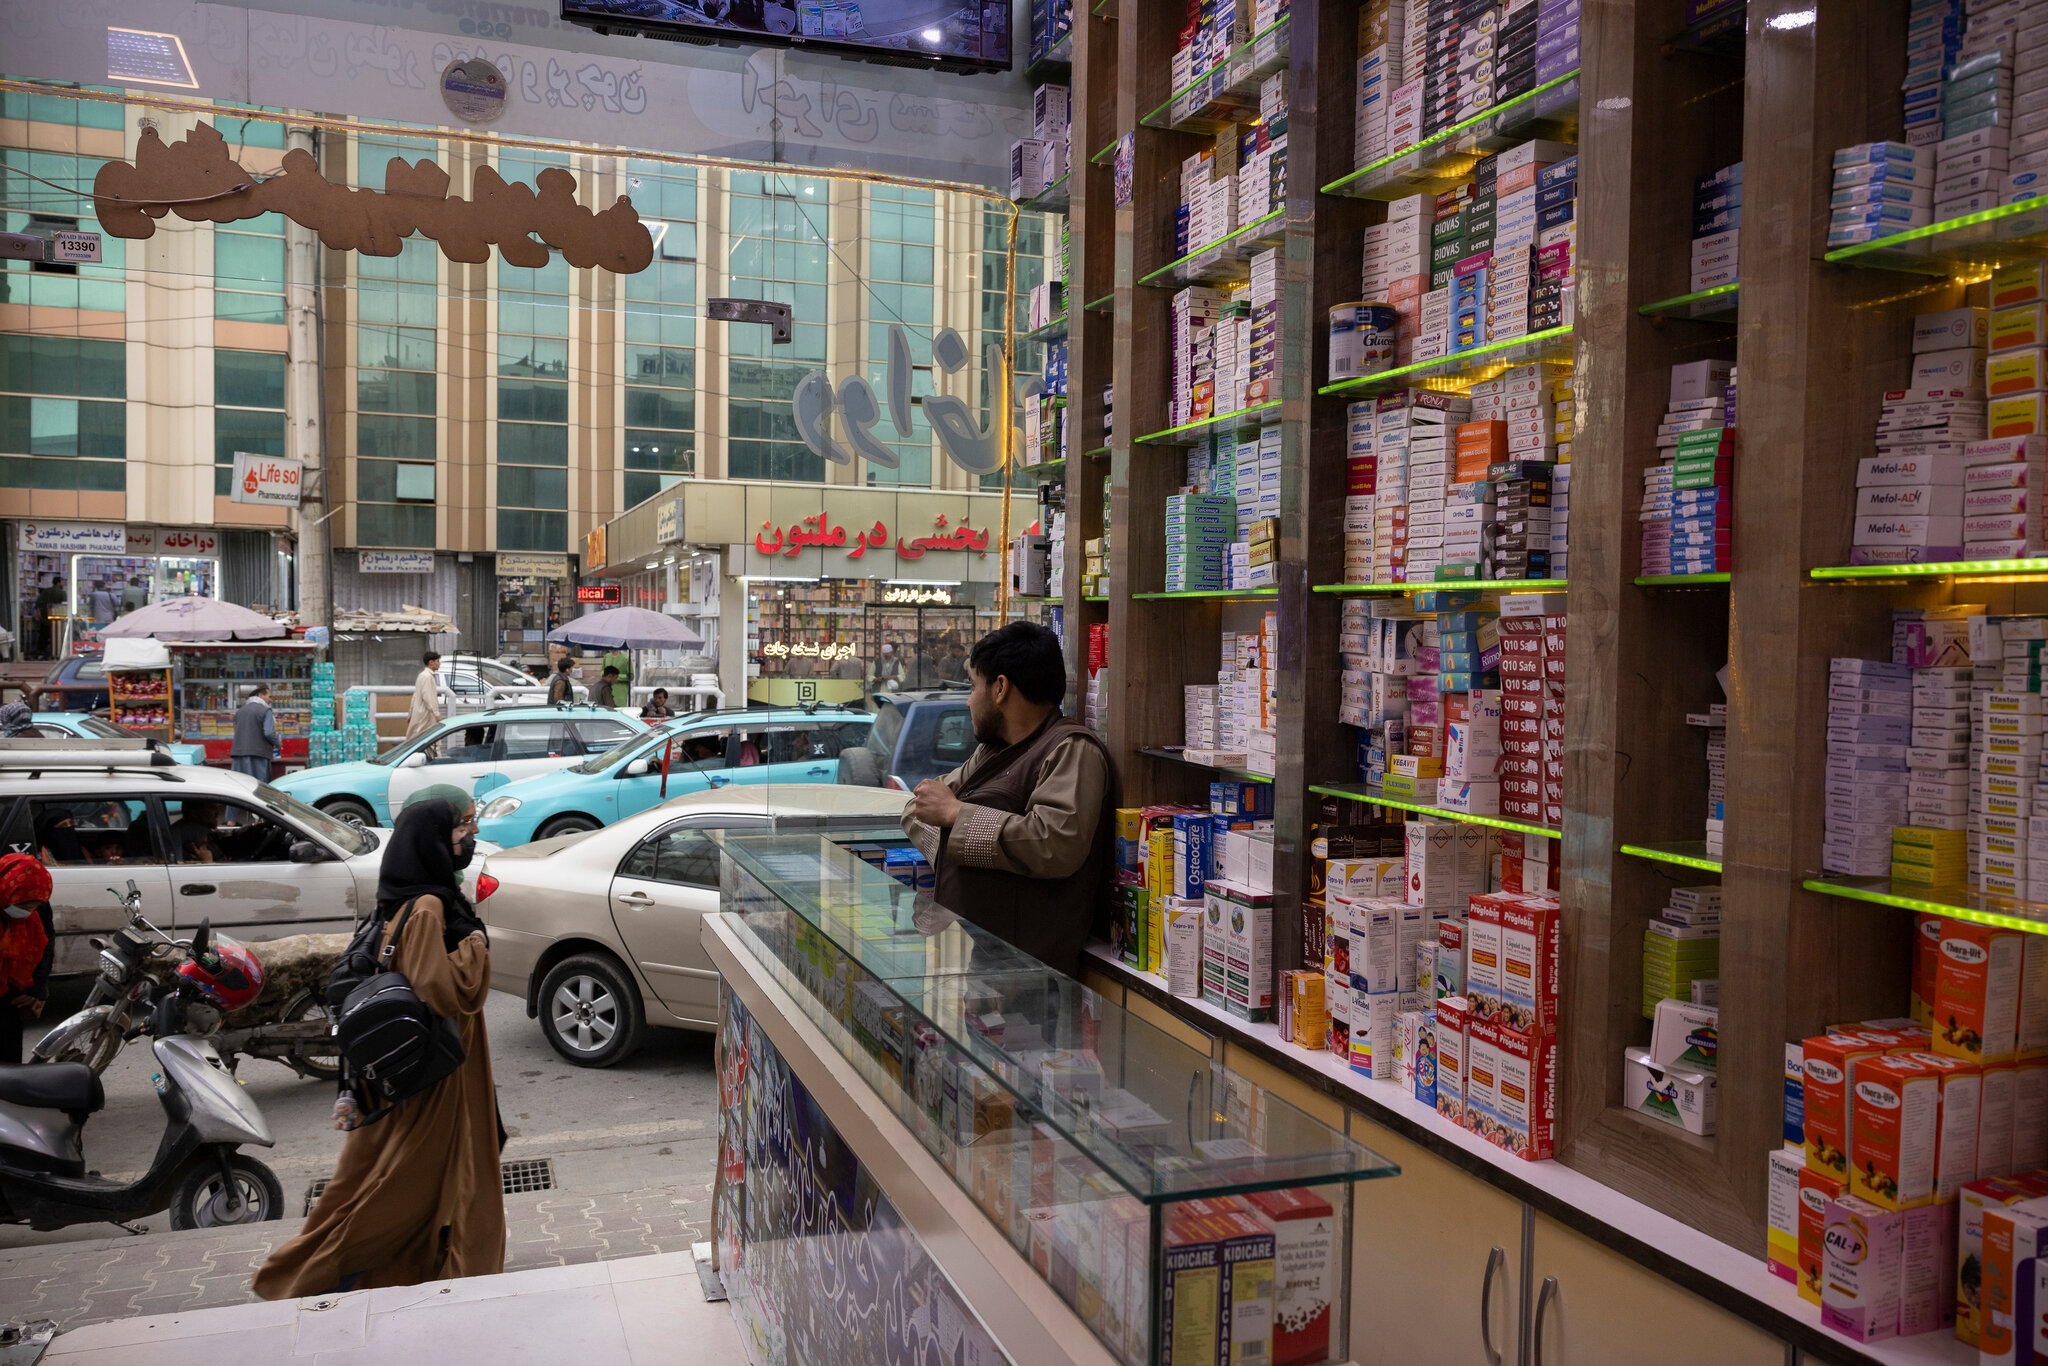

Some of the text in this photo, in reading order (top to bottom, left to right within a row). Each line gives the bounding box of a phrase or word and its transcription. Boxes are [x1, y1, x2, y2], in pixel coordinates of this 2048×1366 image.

[1521, 194, 1534, 204] Forte
[1521, 214, 1535, 223] Forte
[1434, 216, 1460, 236] BIOVAS
[1518, 233, 1532, 243] Forte
[1701, 235, 1730, 250] Symcerin
[60, 240, 96, 252] 13390
[1434, 241, 1460, 261] BIOVAS
[1515, 247, 1530, 258] JOINT
[1700, 253, 1729, 267] Symcerin
[1514, 263, 1529, 272] JOINT
[1434, 269, 1455, 286] BIOVA
[1514, 278, 1528, 287] JOINT
[1700, 271, 1728, 285] Symcerin
[1513, 293, 1527, 301] JOINT
[1363, 332, 1394, 347] Gluce
[259, 462, 301, 486] Life sol
[1871, 462, 1917, 474] Mefol-AD
[257, 489, 299, 501] Pharmaceutical
[1870, 493, 1916, 504] Mefol-AD
[37, 527, 122, 542] نواب هاشمی درملتون
[1868, 523, 1911, 534] Mefol-A
[164, 532, 215, 553] دواخانه
[897, 513, 990, 560] بخشی
[89, 544, 125, 553] PHARMACY
[536, 567, 562, 575] Pharmacy
[1506, 622, 1521, 632] Q10
[763, 641, 856, 661] اجرای نسخه جات
[1503, 640, 1519, 651] Q10
[1502, 660, 1536, 672] Q10 Safe
[1505, 678, 1521, 690] Q10
[1504, 700, 1520, 711] Q10
[1989, 695, 2019, 704] Efaston
[1503, 720, 1519, 731] Q10
[1989, 717, 2019, 725] Efaston
[1504, 741, 1520, 752] Q10
[1989, 737, 2019, 745] Efaston
[1392, 758, 1416, 768] VEGAVIT
[1503, 760, 1519, 772] Q10
[1987, 756, 2017, 765] Efaston
[1386, 780, 1411, 790] FLEXIMED
[1504, 781, 1520, 793] Q10
[1988, 777, 2018, 786] Efaston
[1504, 801, 1520, 813] Q10
[1988, 797, 2018, 807] Efaston
[1985, 818, 2016, 828] Efaston
[1188, 824, 1200, 886] Osteocare
[1327, 875, 1344, 886] Cypro-Vit
[1350, 876, 1374, 885] Cypro-Vit
[1471, 903, 1499, 918] Proglobin
[1504, 911, 1534, 928] Proglobin
[1172, 921, 1195, 932] Cypro-Vit
[1486, 934, 1497, 942] Iron
[1520, 944, 1531, 952] Iron
[1945, 942, 1982, 959] Thera-Vit
[1352, 997, 1370, 1011] L-Vitabol
[1438, 1007, 1460, 1024] Proglobin
[1471, 1022, 1497, 1039] Proglobin
[1500, 1034, 1528, 1052] Proglobin
[1514, 1068, 1526, 1078] Iron
[1807, 1063, 1839, 1080] Thera-Vit
[1861, 1084, 1895, 1104] Thera-Vit
[1826, 1231, 1862, 1254] CAL-P
[1224, 1242, 1274, 1262] KIDICARE
[1296, 1251, 1308, 1260] Acid
[1314, 1249, 1326, 1257] Zinc
[1167, 1250, 1216, 1269] KIDICARE
[1309, 1260, 1325, 1270] Syrup
[1831, 1261, 1858, 1277] CALCIUM
